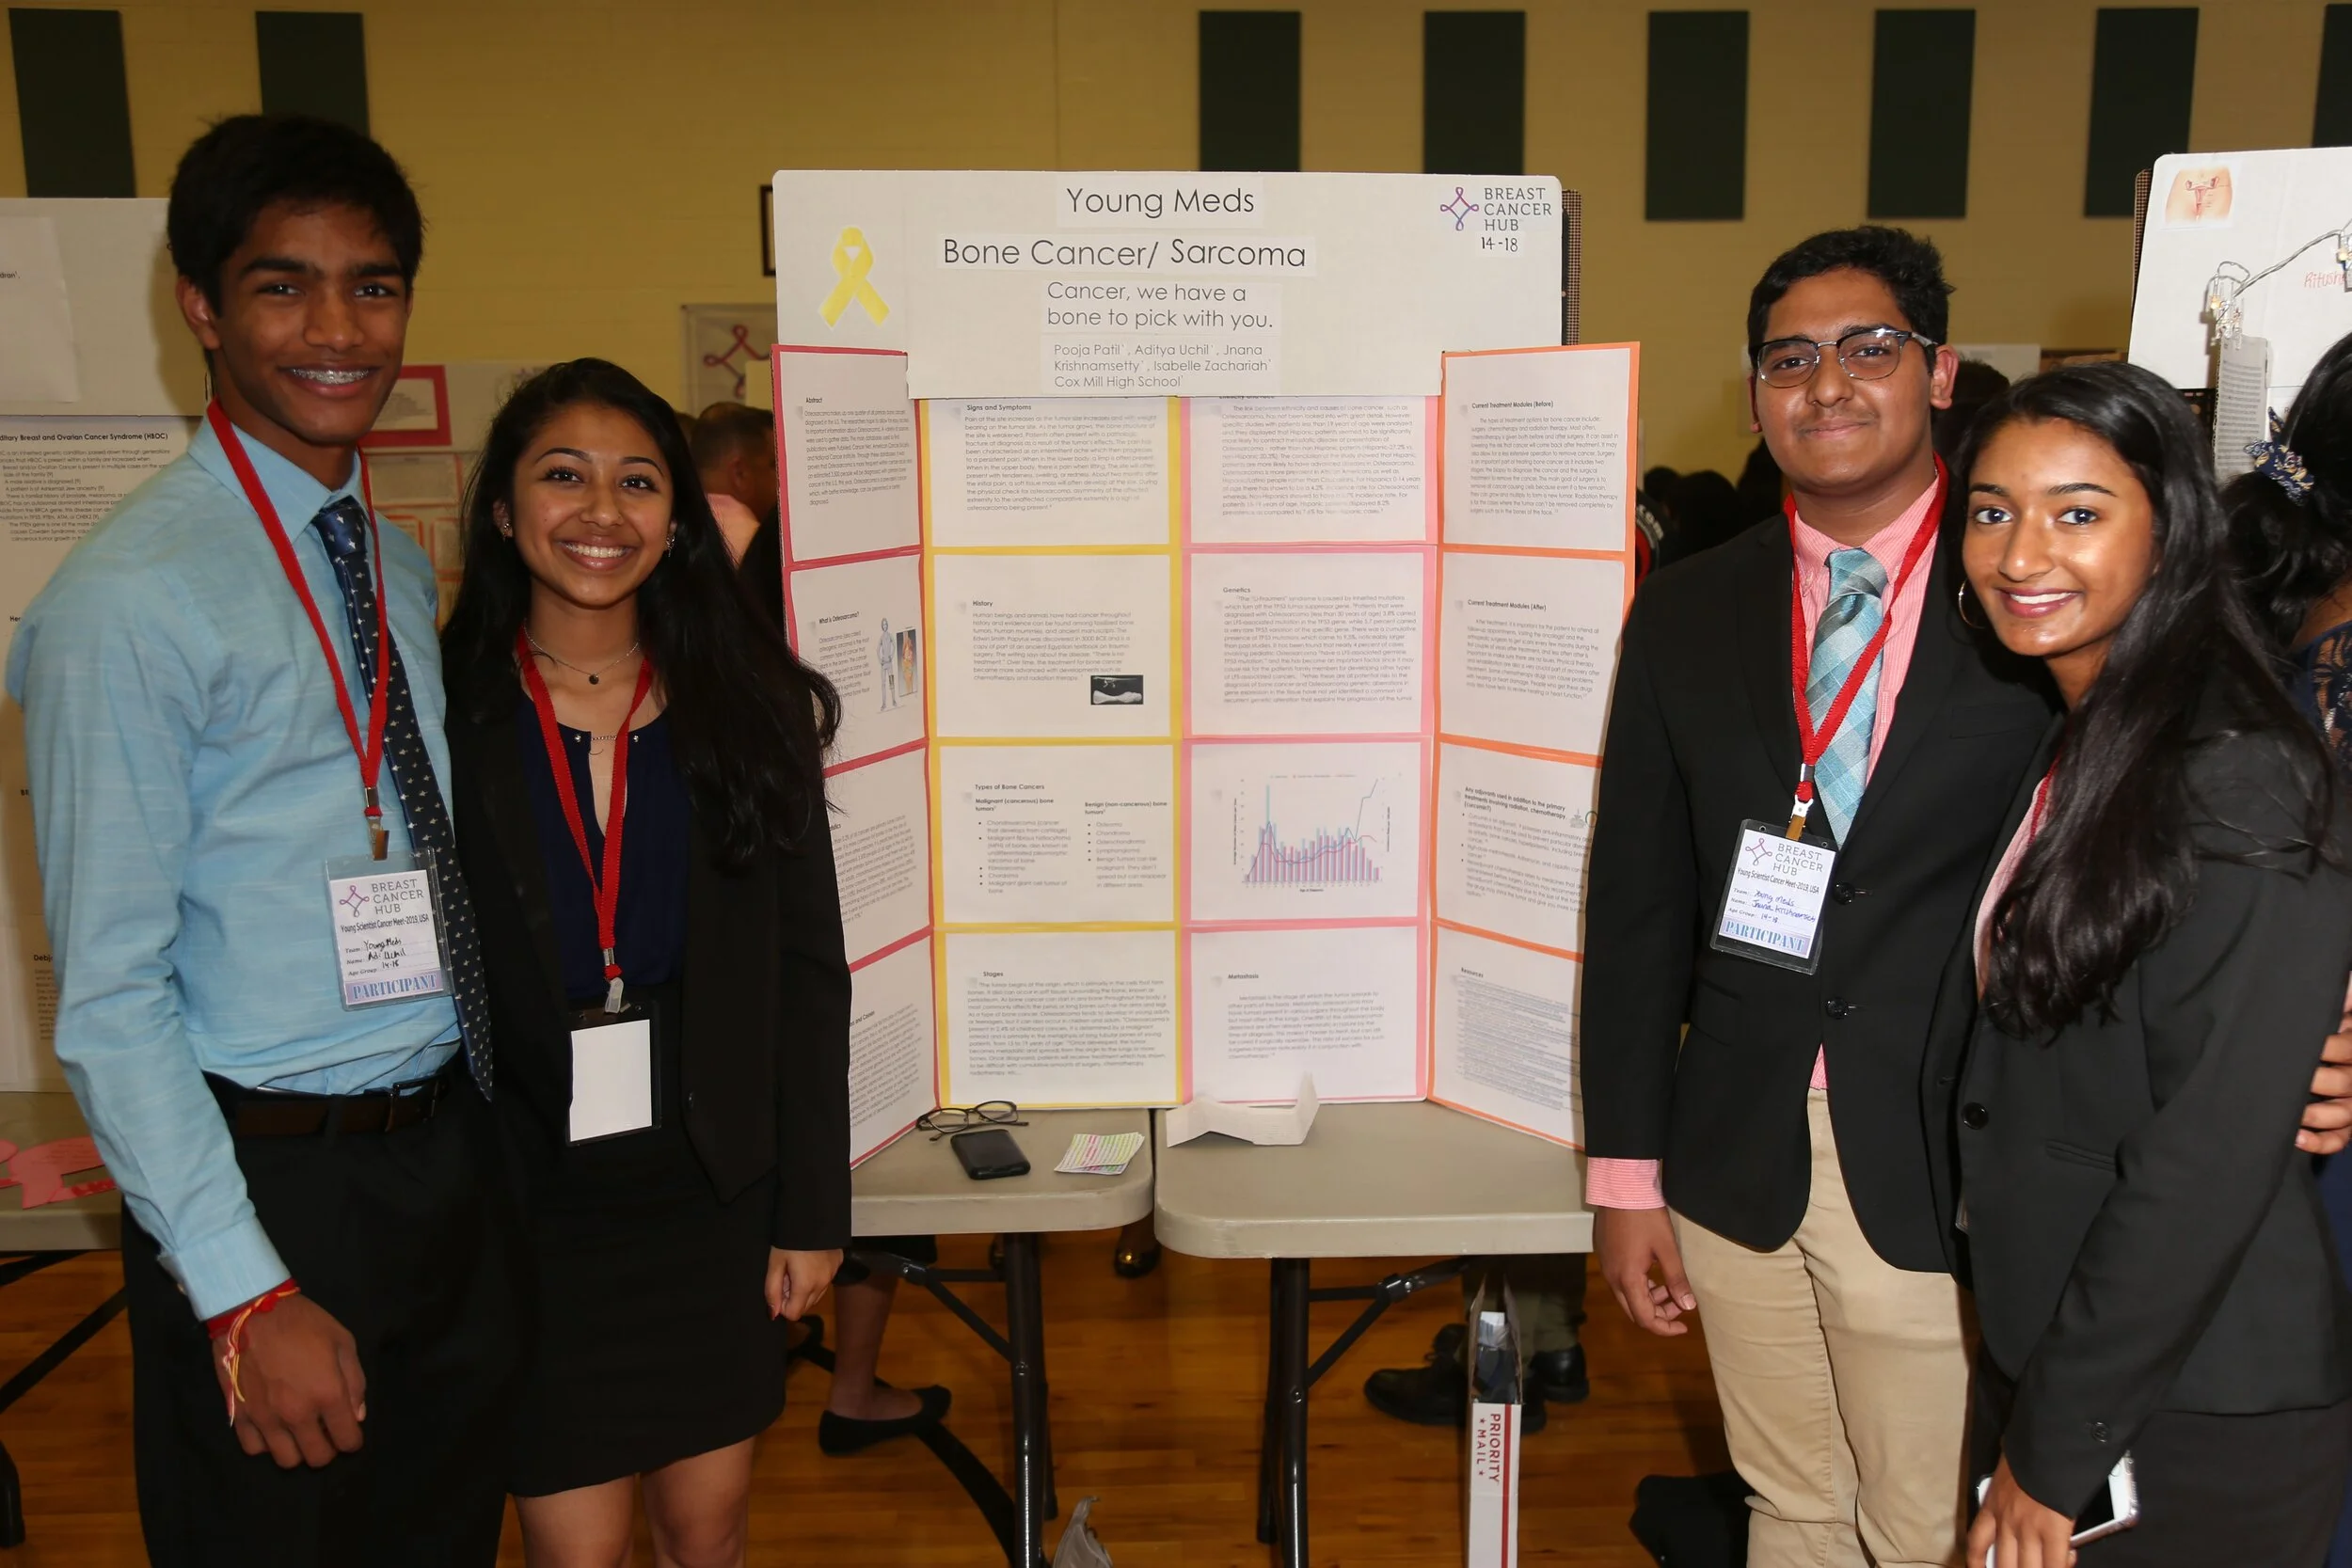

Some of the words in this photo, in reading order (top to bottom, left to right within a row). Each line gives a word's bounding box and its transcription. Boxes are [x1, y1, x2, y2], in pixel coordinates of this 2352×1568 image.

[1485, 188, 1545, 199] BREAST
[1067, 188, 1162, 219] Young
[1174, 188, 1254, 212] Meds
[1485, 204, 1552, 215] CANCER
[1485, 219, 1518, 231] HUB
[944, 239, 1020, 263] Bone
[1031, 239, 1159, 269] Cancer/
[1171, 239, 1305, 266] Sarcoma
[1048, 281, 1130, 300] Cancer,
[1137, 287, 1167, 299] we
[1175, 284, 1226, 301] have
[1233, 287, 1246, 301] a
[1048, 307, 1101, 325] bone
[1109, 308, 1127, 325] to
[1135, 309, 1177, 329] pick
[1184, 309, 1223, 327] with
[1231, 313, 1272, 330] you.
[1054, 345, 1090, 357] Pooja
[1135, 344, 1175, 357] Aditya
[1223, 344, 1262, 355] Jnana
[1154, 360, 1201, 371] Isabelle
[1054, 377, 1080, 387] Cox
[1083, 376, 1102, 387] Mill
[1107, 376, 1134, 389] High
[1778, 843, 1822, 860] BREAST
[1773, 863, 1797, 876] HUB
[1775, 854, 1823, 872] CANCER
[372, 879, 417, 892] BREAST
[1738, 867, 1751, 878] Young
[1751, 870, 1770, 881] Scientist
[1770, 876, 1785, 884] Cancer
[1810, 885, 1819, 894] USA
[373, 890, 424, 903] CANCER
[375, 904, 401, 914] HUB
[341, 925, 356, 933] Young
[357, 922, 377, 931] Scientist
[419, 914, 429, 922] USA
[1726, 921, 1804, 950] PARTICIPANT
[364, 940, 385, 951] Young
[386, 938, 402, 946] Meds
[353, 974, 437, 999] PARTICIPANT
[1476, 1429, 1487, 1465] MAIL
[1489, 1414, 1501, 1484] PRIORITY
